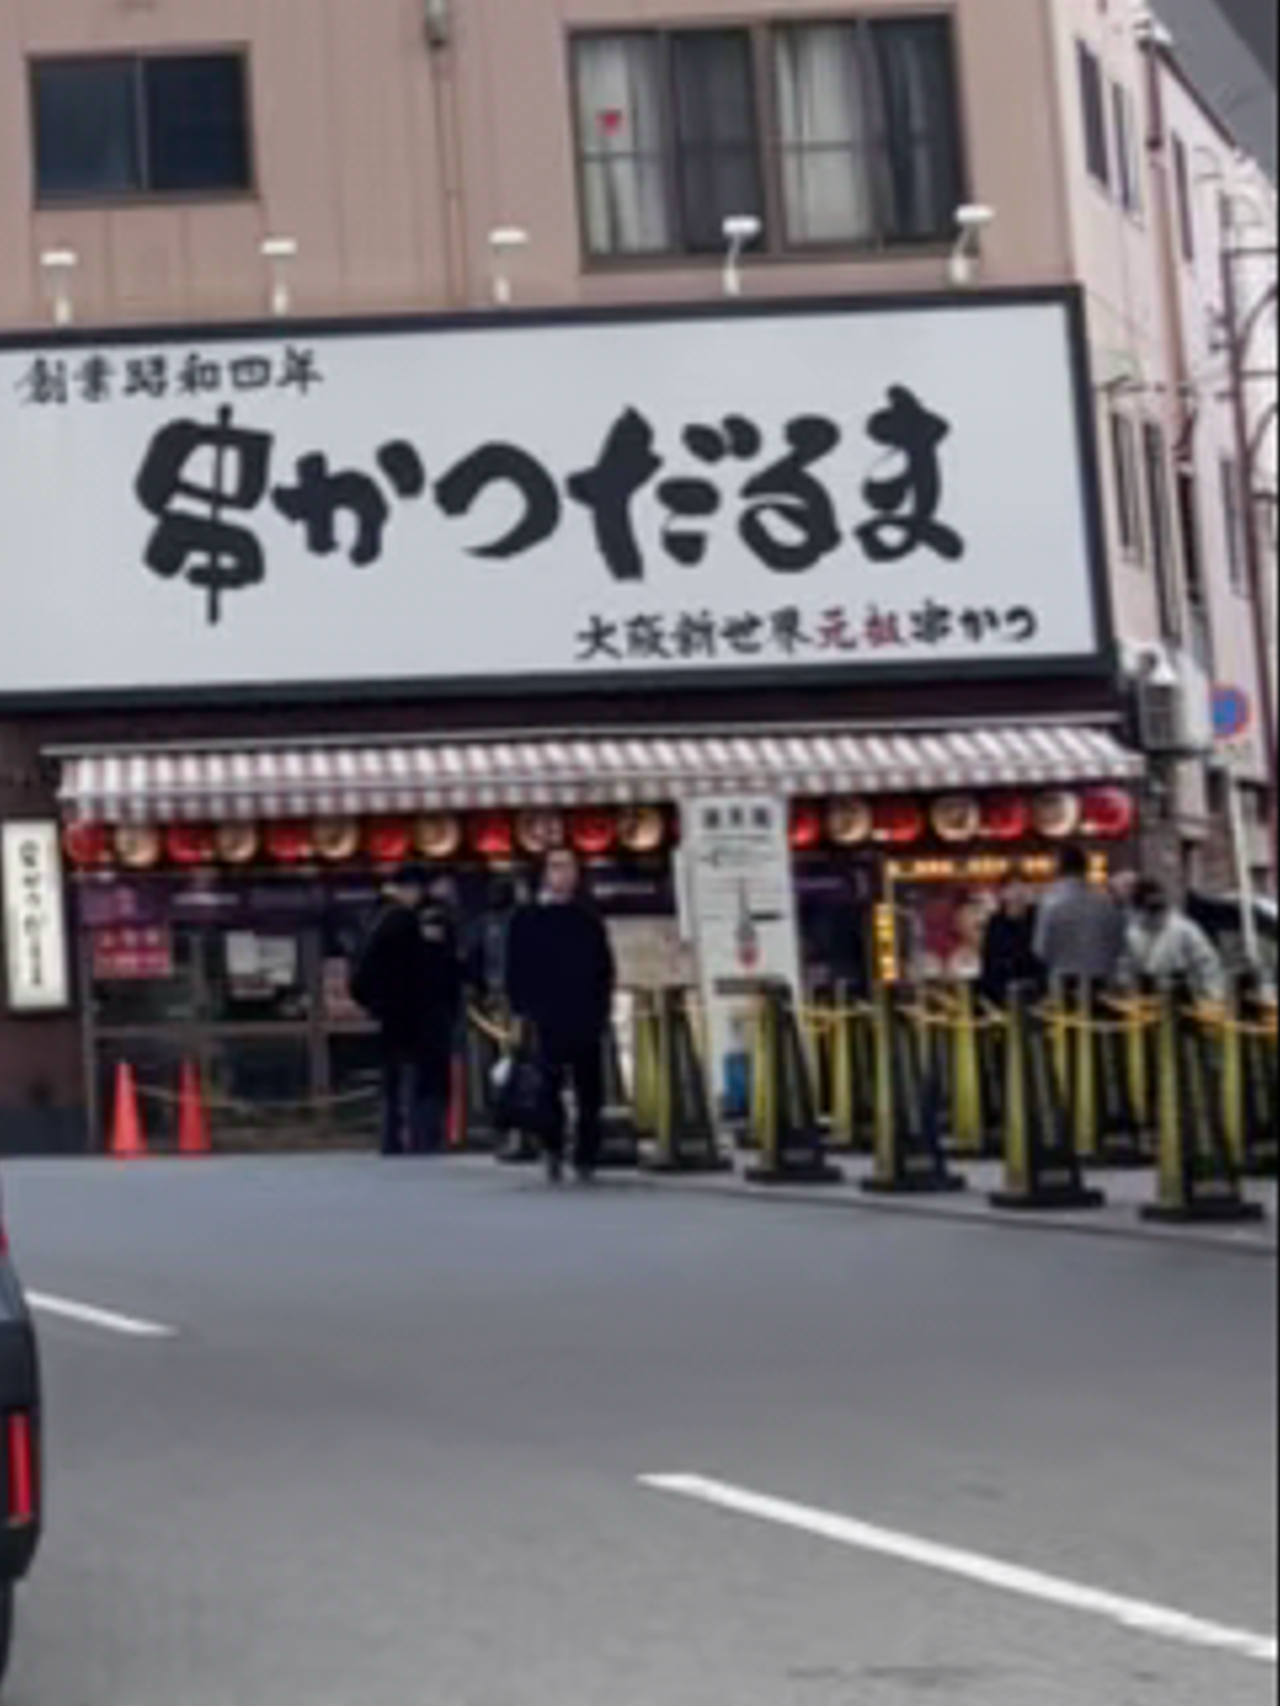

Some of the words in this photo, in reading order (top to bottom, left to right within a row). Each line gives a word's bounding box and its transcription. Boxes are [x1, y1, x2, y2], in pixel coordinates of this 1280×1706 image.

[14, 343, 326, 405] 創業昭和四年
[135, 383, 965, 626] 串かつだるま
[574, 595, 1040, 662] 大阪新世界元祖串かつ
